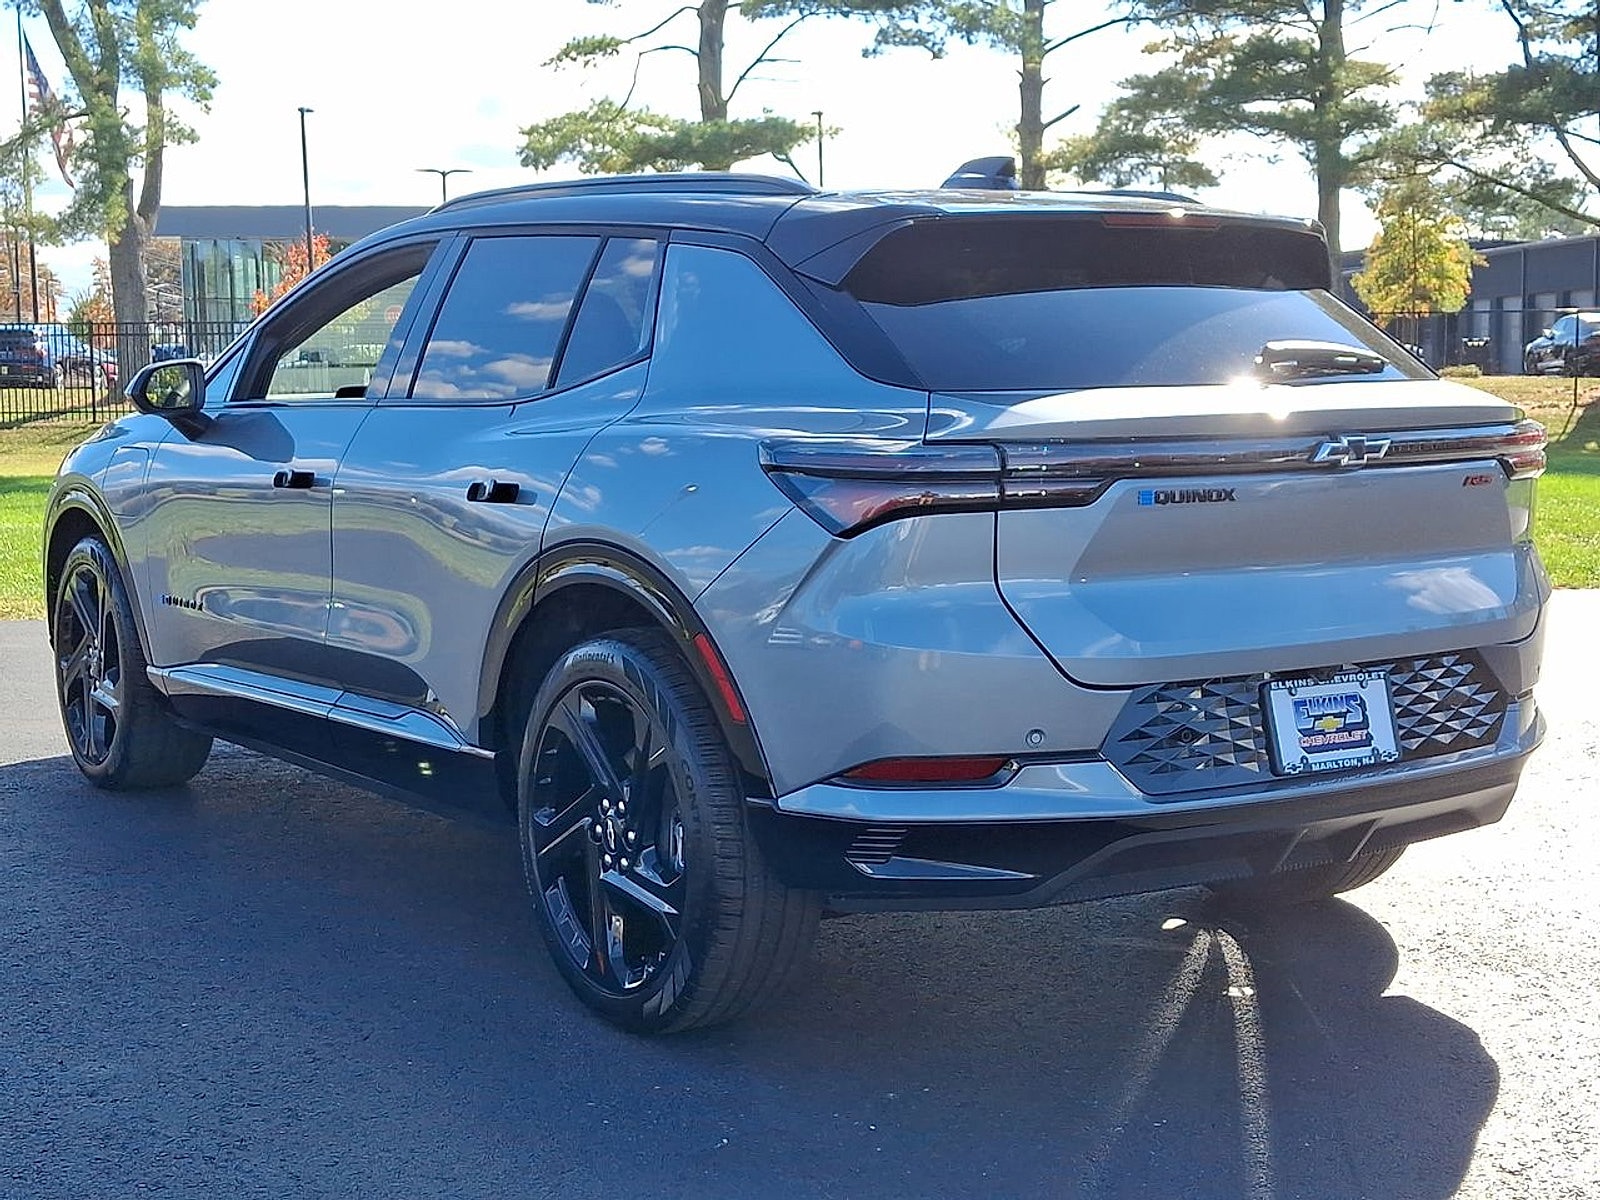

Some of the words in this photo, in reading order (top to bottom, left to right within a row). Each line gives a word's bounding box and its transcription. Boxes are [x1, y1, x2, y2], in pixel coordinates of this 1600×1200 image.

[1462, 475, 1492, 487] RS
[1138, 488, 1237, 505] EQUINOX
[1270, 678, 1315, 690] ELKINS
[1318, 671, 1386, 685] EVROLET
[1293, 693, 1364, 729] ELKINS
[1300, 730, 1369, 748] CHEVROLET
[1311, 758, 1361, 771] MARLTON,
[1362, 756, 1375, 766] NJ
